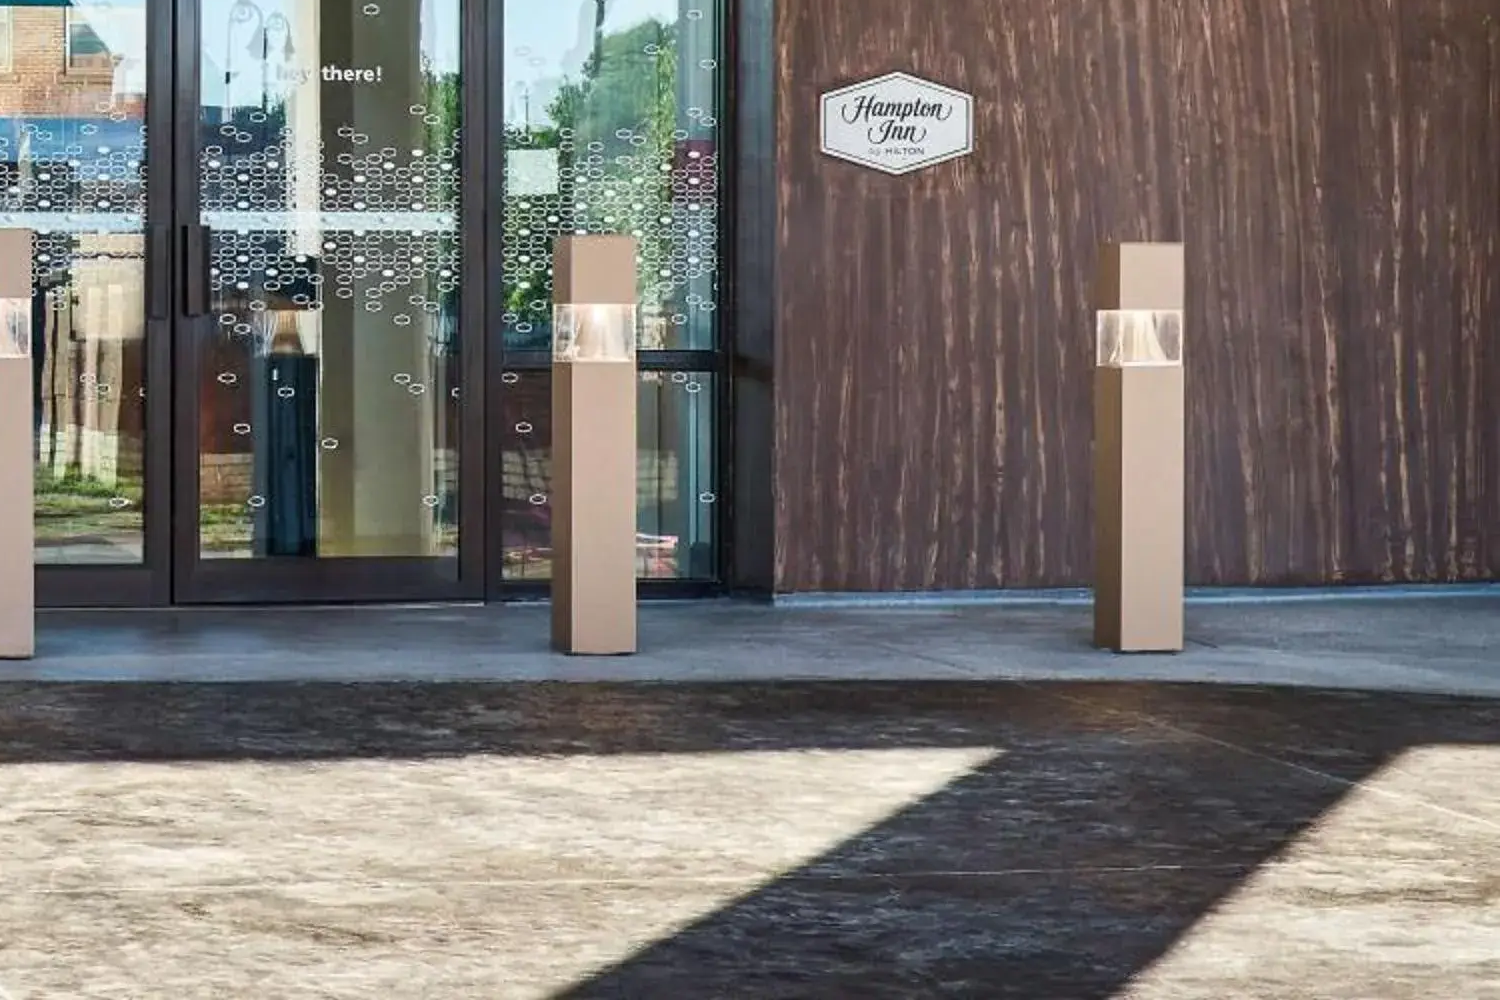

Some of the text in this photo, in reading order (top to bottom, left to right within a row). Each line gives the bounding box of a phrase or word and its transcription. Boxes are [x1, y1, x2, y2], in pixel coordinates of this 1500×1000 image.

[321, 64, 383, 82] there!
[841, 94, 953, 124] Hampton
[867, 119, 927, 144] Inn
